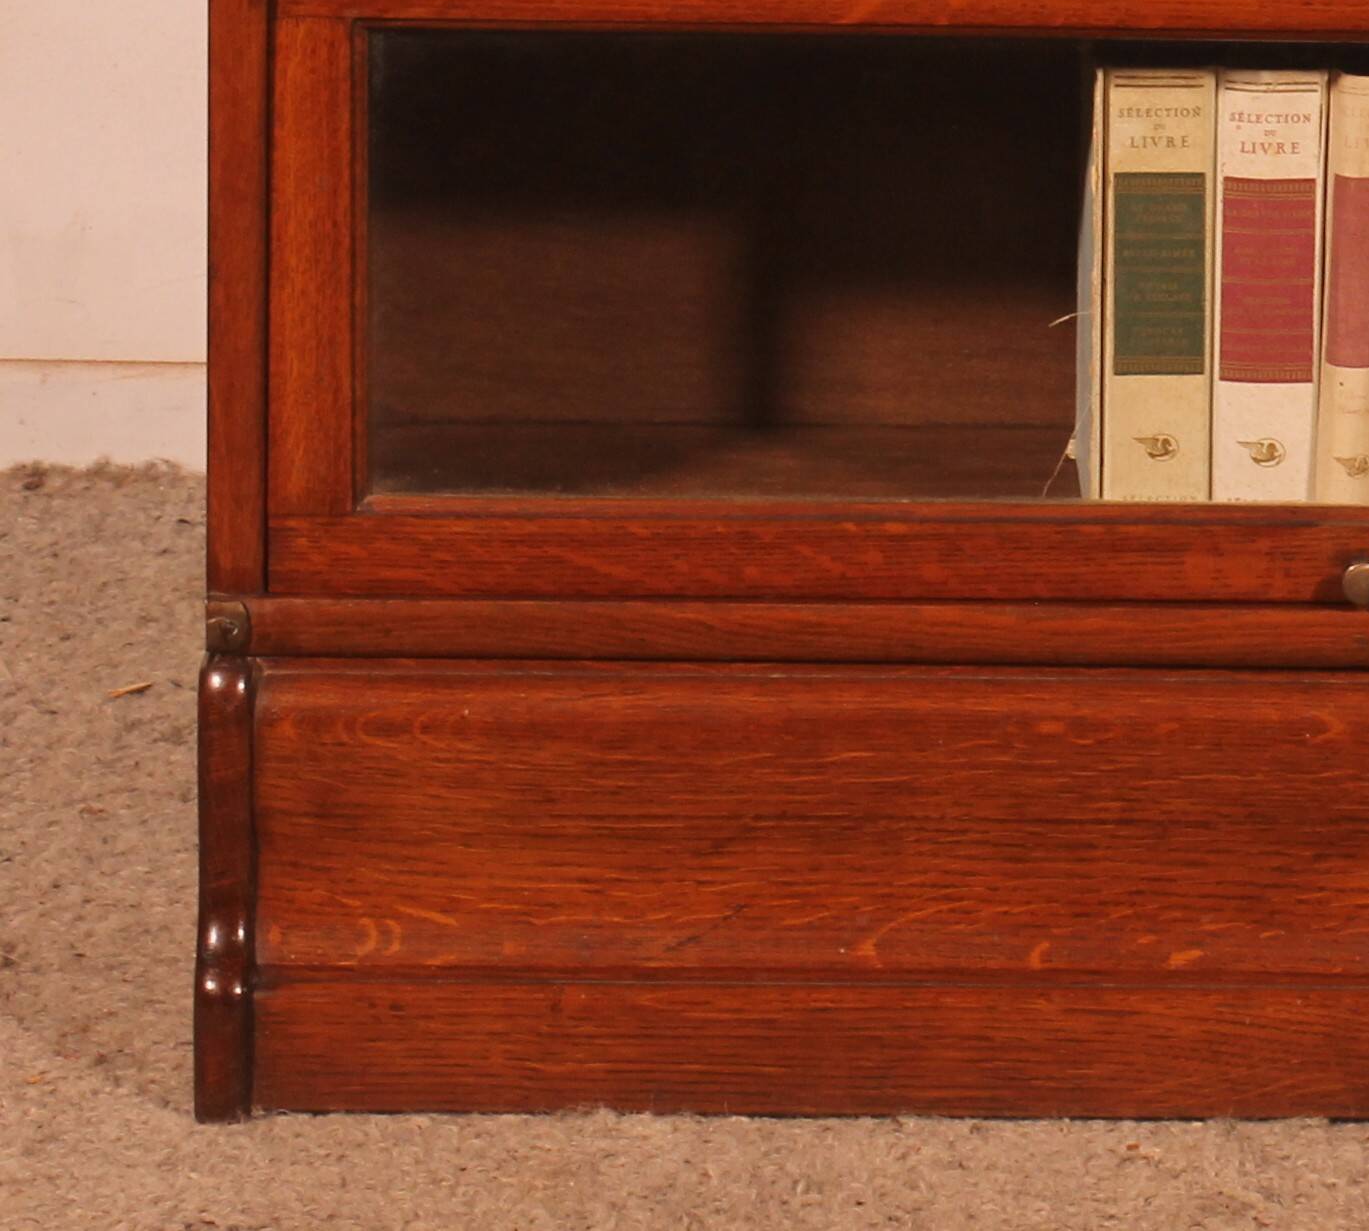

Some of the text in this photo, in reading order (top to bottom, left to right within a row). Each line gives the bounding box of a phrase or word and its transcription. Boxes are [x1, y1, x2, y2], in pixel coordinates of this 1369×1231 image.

[1117, 104, 1202, 119] SÉLECTION
[1229, 110, 1312, 125] SÉLECTION
[1129, 135, 1190, 149] LIVRE
[1239, 141, 1301, 156] LIVRE
